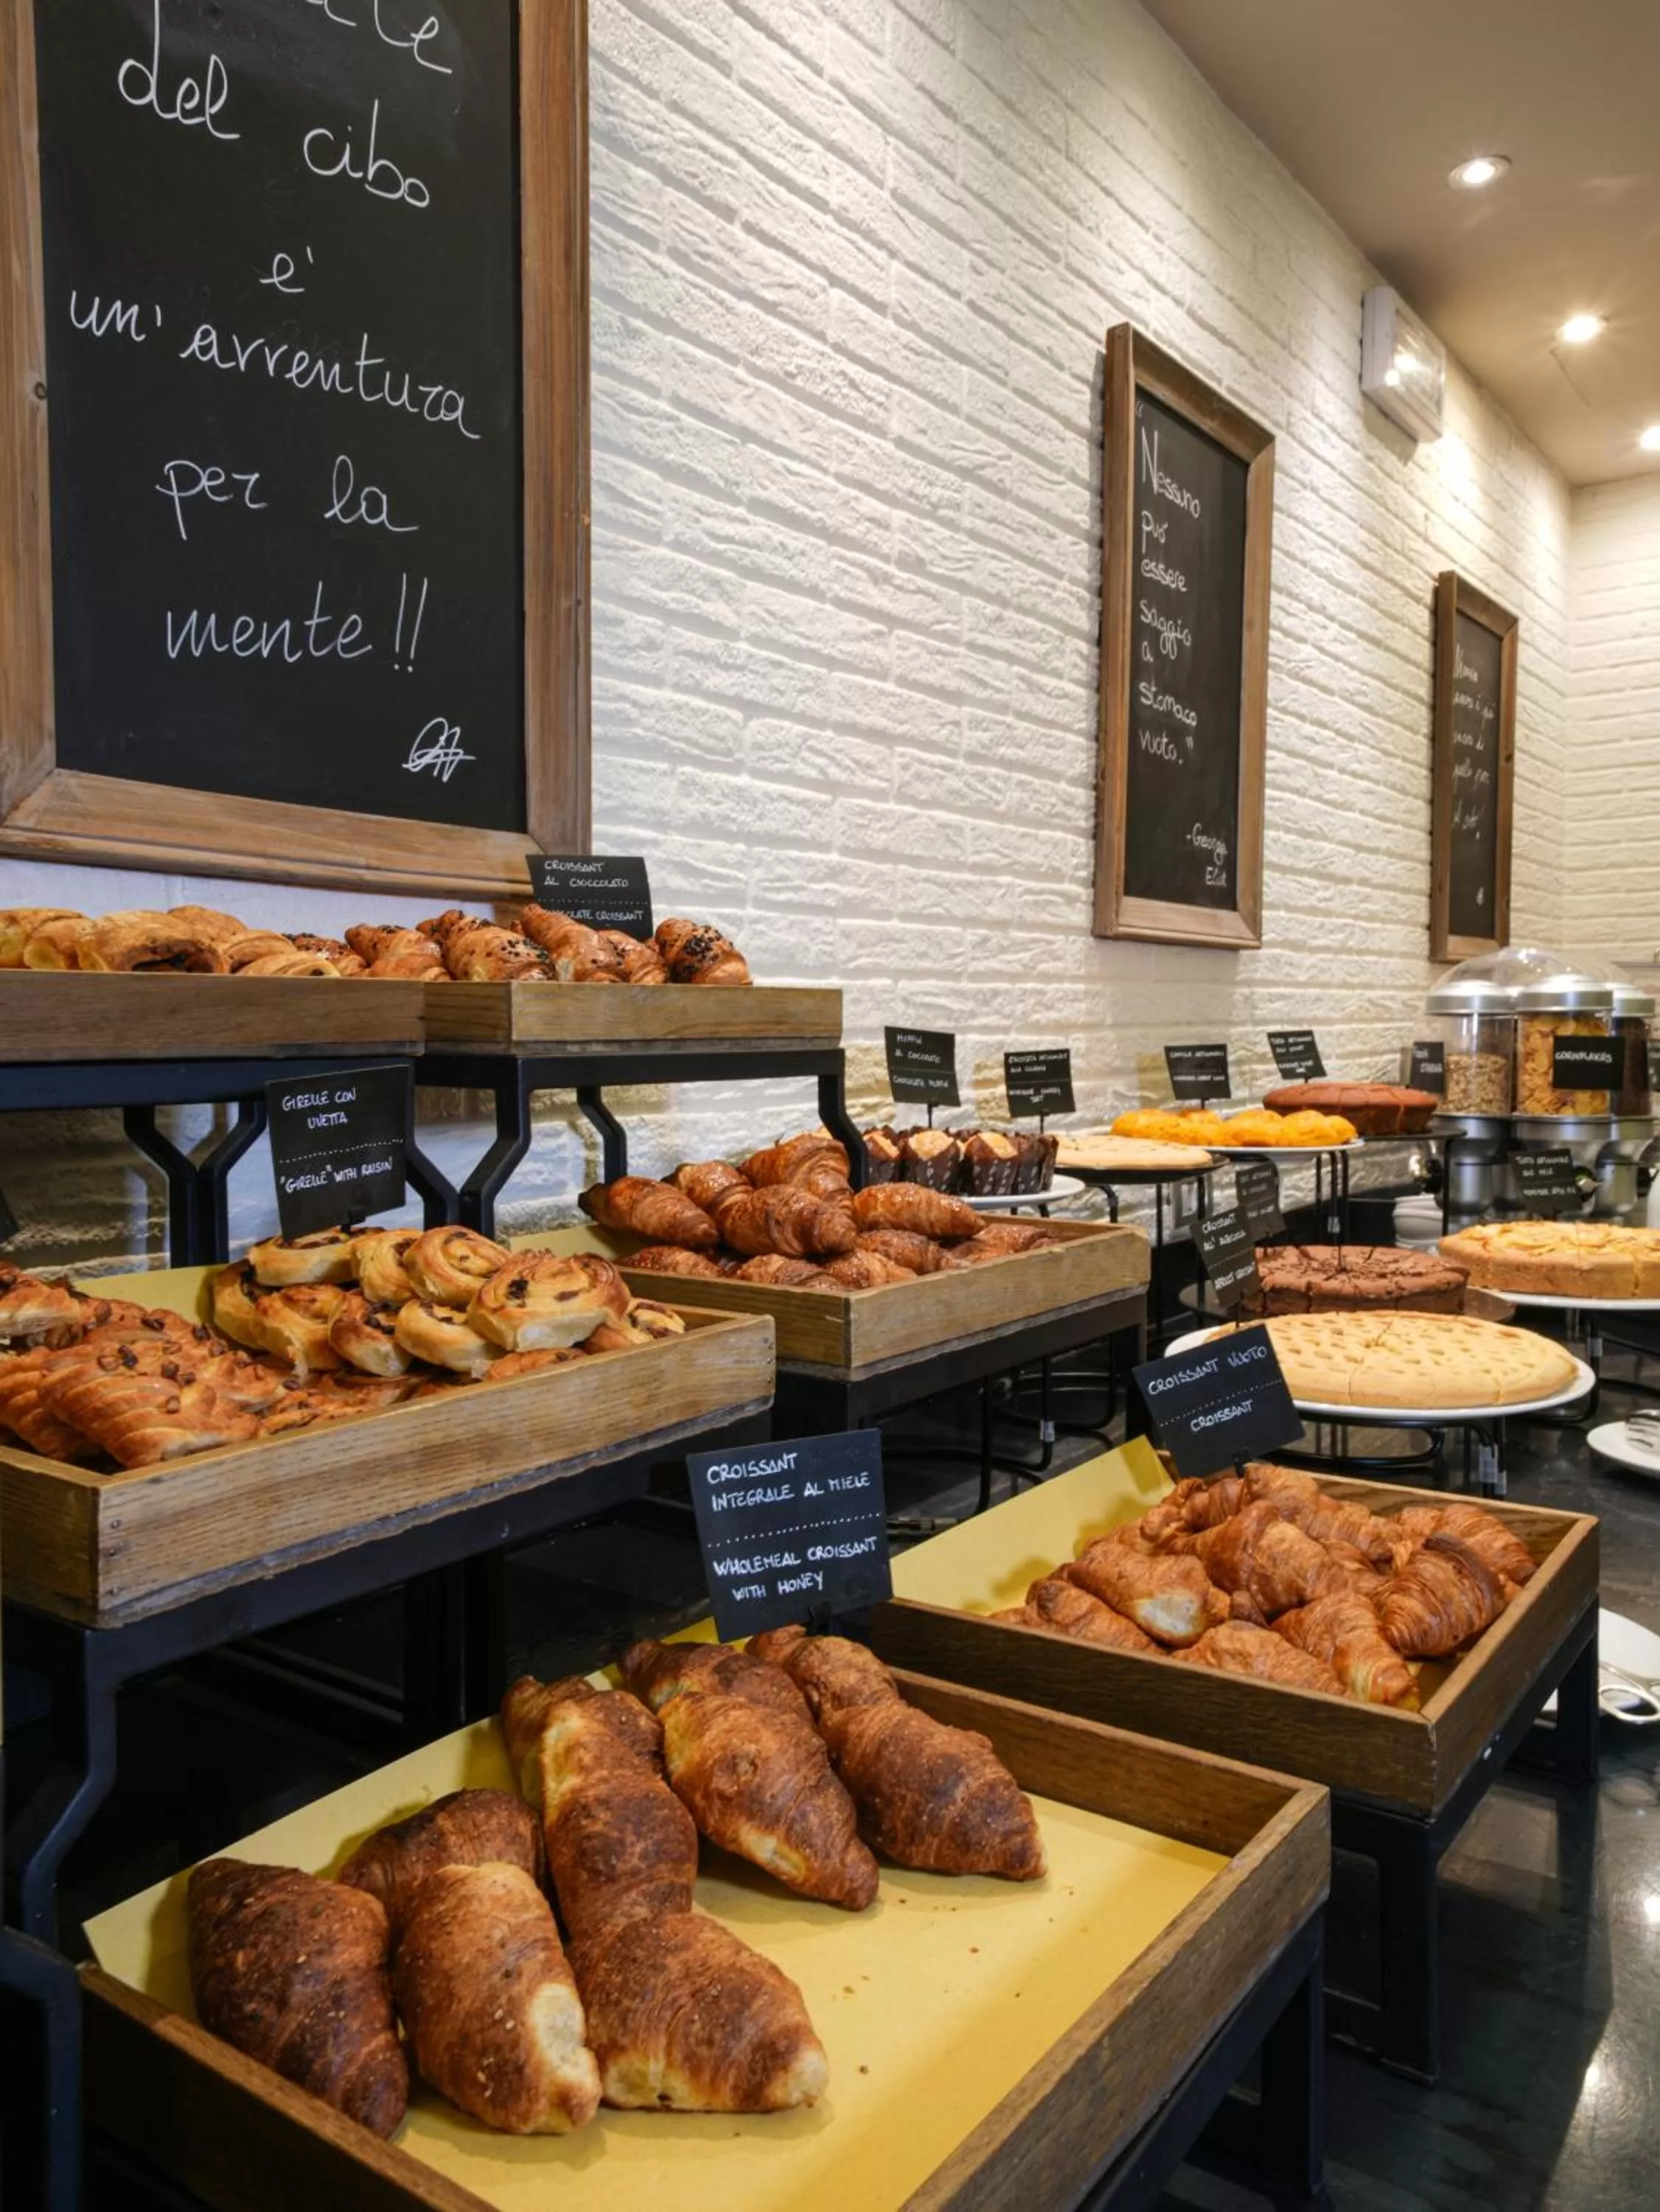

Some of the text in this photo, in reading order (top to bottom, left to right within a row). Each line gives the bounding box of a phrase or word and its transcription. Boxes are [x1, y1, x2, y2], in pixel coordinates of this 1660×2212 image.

[118, 0, 240, 139] del
[303, 99, 430, 207] cibo
[156, 455, 419, 540] per la
[1142, 559, 1187, 591] essere
[544, 860, 604, 873] CROISSANT
[544, 874, 560, 886] AL
[595, 910, 644, 921] CROISSANT
[282, 1087, 357, 1111] GIRELLE CON
[307, 1111, 348, 1129] UVETTA
[334, 1166, 358, 1183] WITH
[361, 1155, 393, 1176] RAISIN
[1148, 1345, 1267, 1395] CROISSANT VUOTO
[1190, 1399, 1253, 1431] CROISSANT
[707, 1452, 798, 1484] CROISSANT
[711, 1472, 871, 1512] INTEGRALE AL MIELE
[713, 1536, 877, 1577] WHOLEMEAL CROISSANT
[732, 1571, 823, 1601] WITH HONEY
